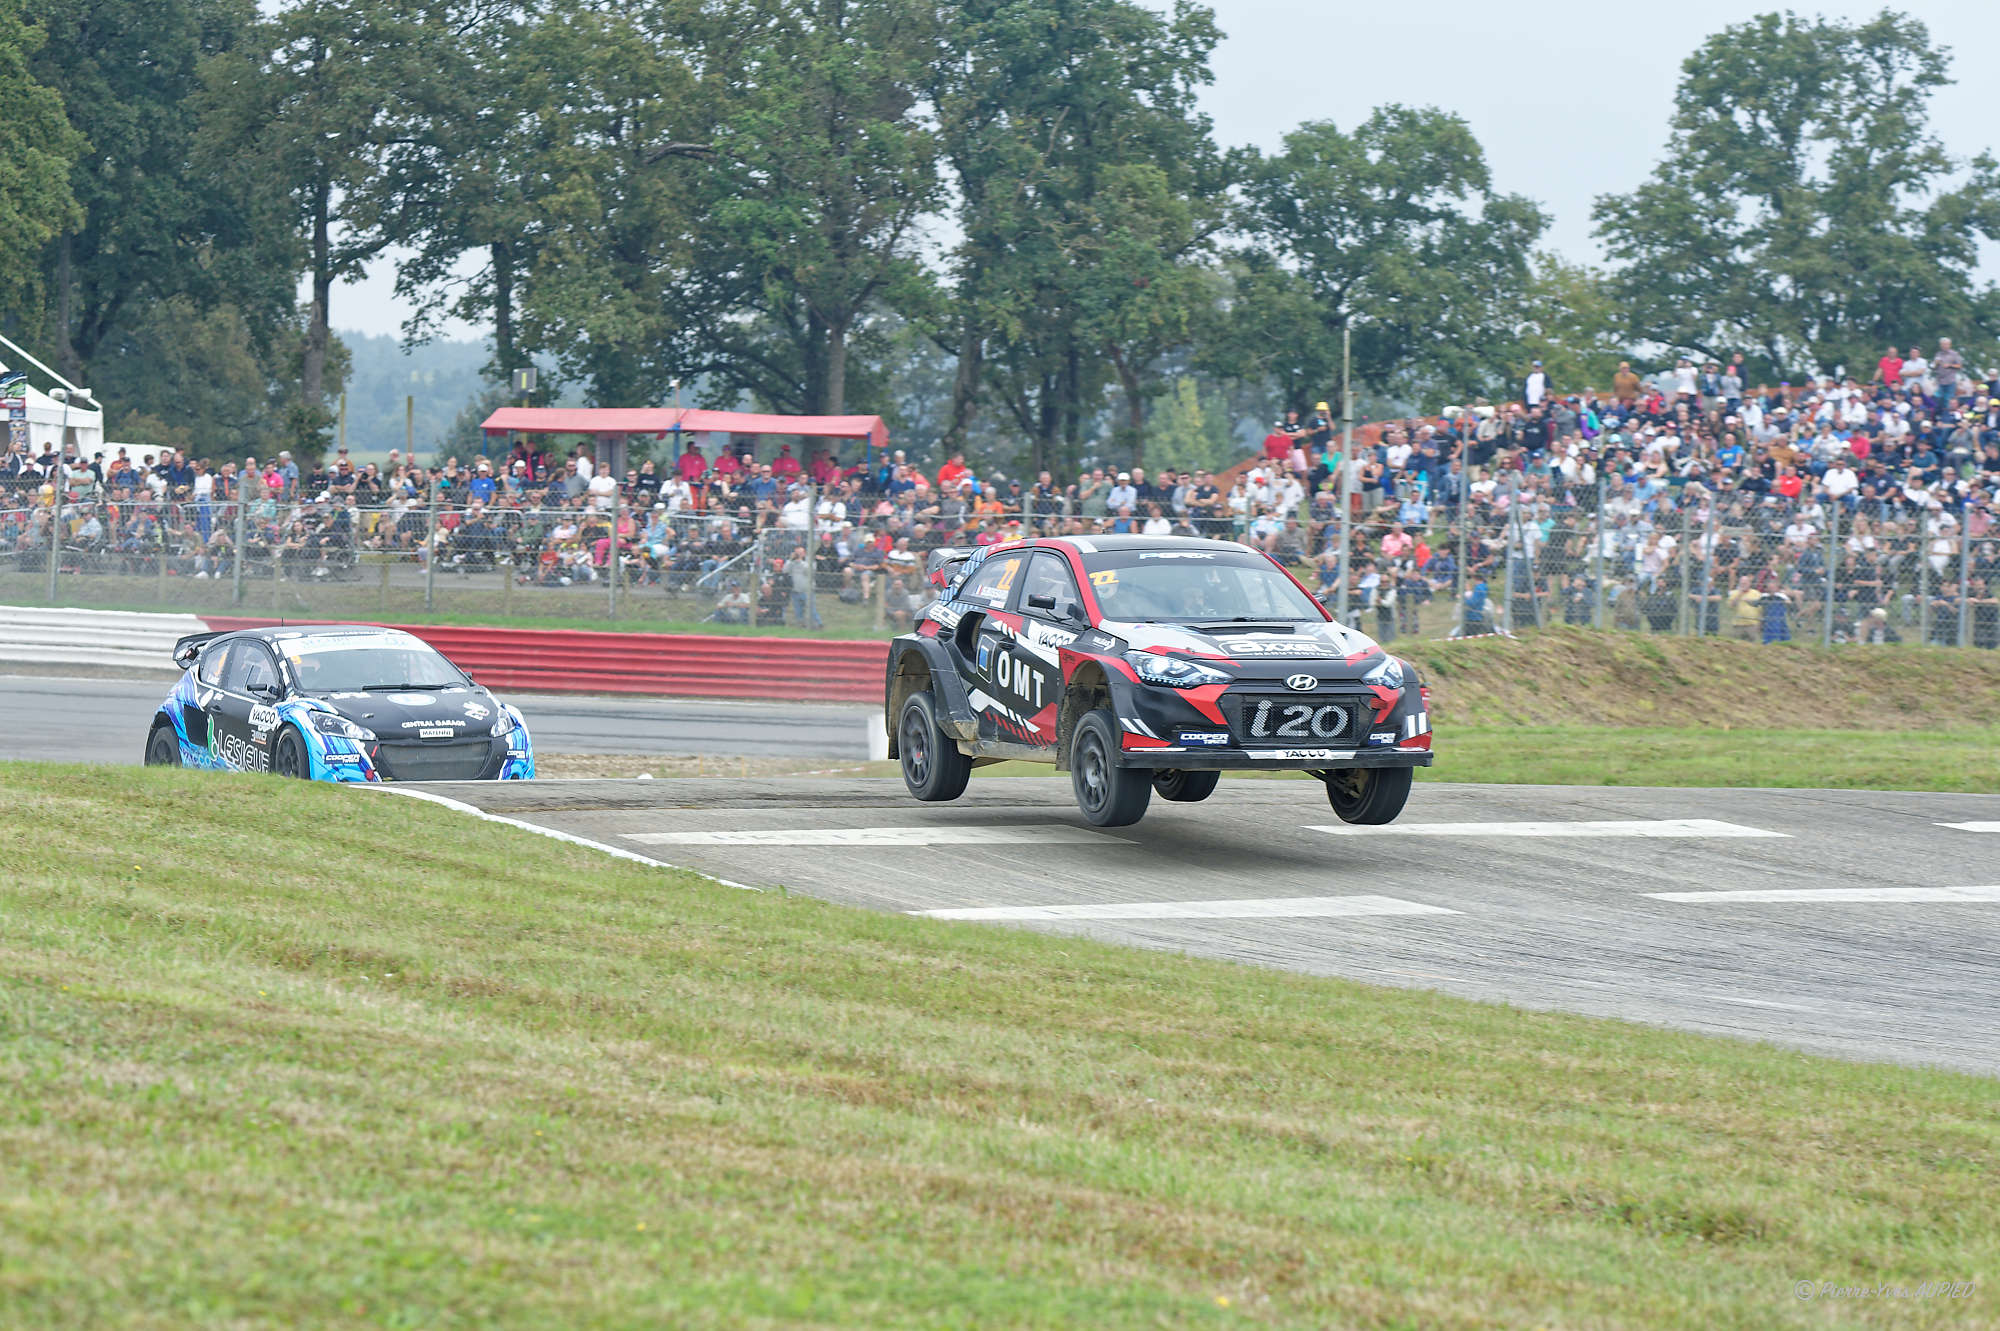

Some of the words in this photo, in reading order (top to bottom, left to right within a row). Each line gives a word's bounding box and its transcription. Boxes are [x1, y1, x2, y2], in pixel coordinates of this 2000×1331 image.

[997, 650, 1045, 709] OMT
[252, 707, 276, 725] YACCO
[1250, 699, 1349, 738] i20
